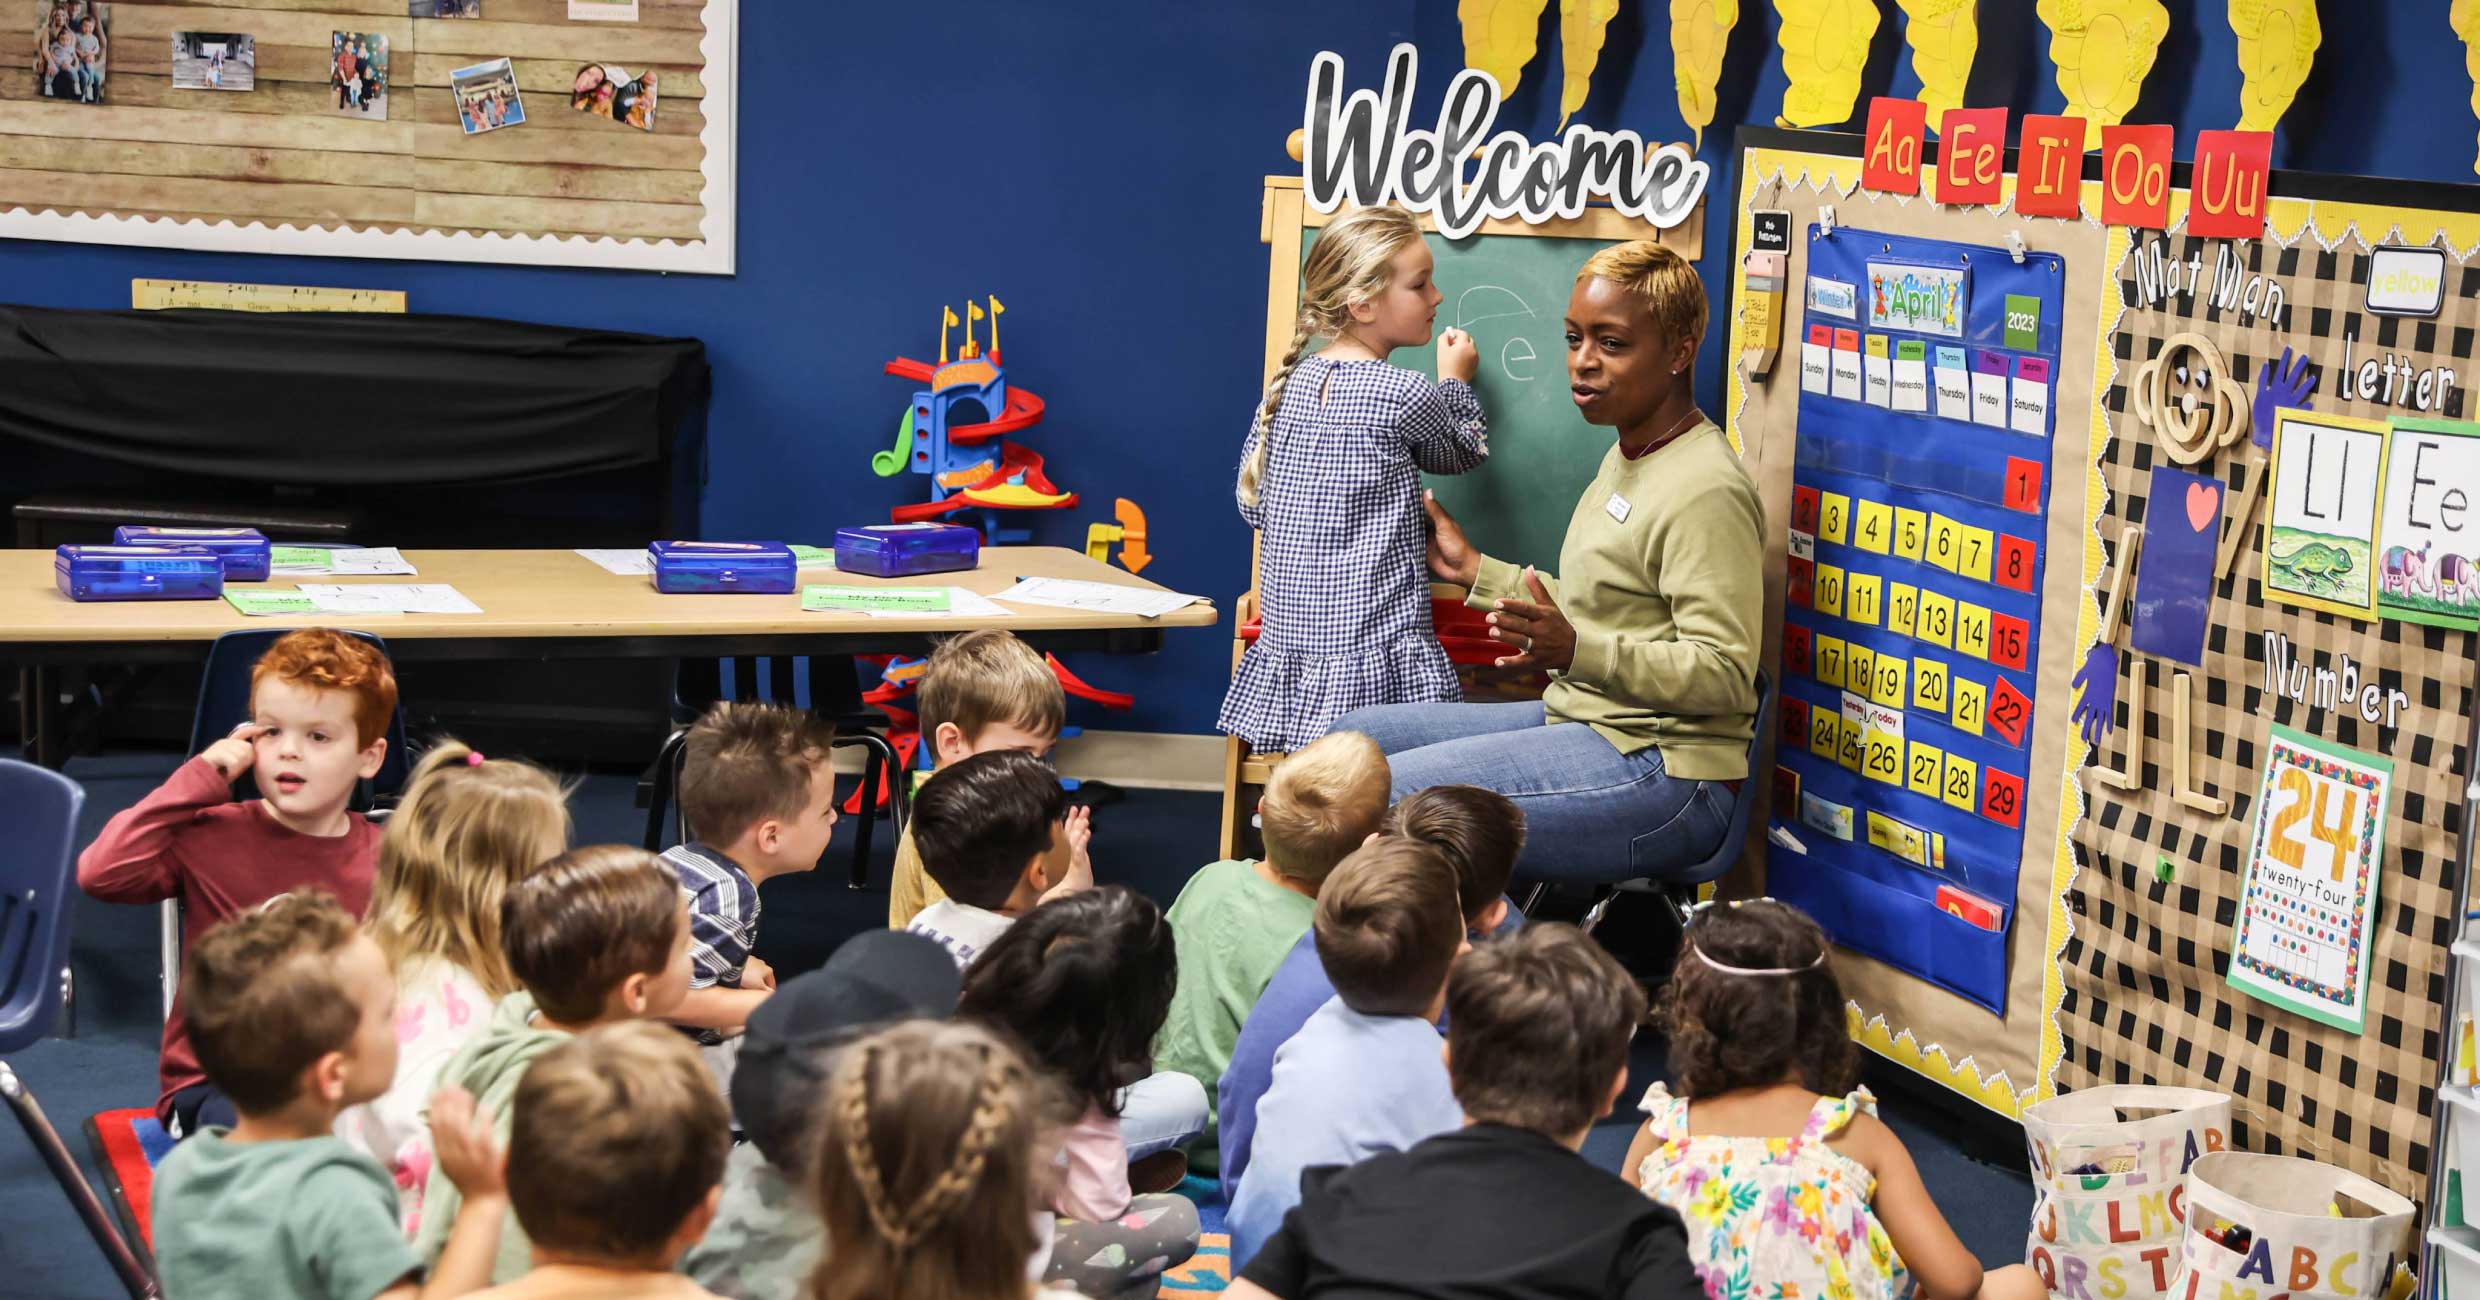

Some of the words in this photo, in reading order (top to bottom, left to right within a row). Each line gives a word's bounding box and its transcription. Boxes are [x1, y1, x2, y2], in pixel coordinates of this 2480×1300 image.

[1310, 52, 1701, 230] Welcome
[1869, 117, 1916, 176] Aa
[1949, 123, 1997, 187] Ee
[2033, 136, 2069, 195] Ii
[2110, 143, 2164, 207] Oo
[2200, 150, 2260, 218] Uu
[1891, 281, 1942, 325] April
[2007, 312, 2035, 333] 2023
[2133, 239, 2203, 310] Mat
[2208, 243, 2286, 325] Man
[2372, 267, 2439, 297] yellow
[1501, 336, 1537, 382] e
[1805, 362, 1825, 377] Sunday
[1835, 367, 1857, 382] Monday
[1868, 374, 1887, 388] Tuesday
[1894, 379, 1925, 392] Wednesday
[1938, 386, 1966, 402] Thursday
[1979, 393, 1999, 408] Friday
[2014, 398, 2043, 415] Saturday
[2017, 472, 2026, 503] 1
[2408, 441, 2468, 532] Ee
[1800, 497, 1811, 526] 2
[1828, 505, 1839, 534] 3
[1865, 513, 1878, 543] 4
[1905, 522, 1916, 550] 5
[1938, 527, 1950, 556] 6
[1970, 540, 1982, 569] 7
[2008, 548, 2021, 579] 8
[1819, 575, 1838, 606] 10
[1854, 585, 1872, 616] 11
[1896, 596, 1913, 627] 12
[1924, 605, 1947, 636] 13
[1963, 617, 1984, 648] 14
[1998, 629, 2021, 659] 15
[1821, 648, 1840, 678] 17
[1852, 663, 1868, 695] 18
[1877, 667, 1898, 697] 19
[1920, 670, 1942, 702] 20
[1959, 690, 1979, 722] 21
[1993, 692, 2023, 733] 22
[2262, 630, 2410, 729] Number
[1815, 719, 1834, 750] 24
[1842, 729, 1859, 761] 25
[1868, 742, 1896, 774] 26
[1913, 754, 1936, 787] 27
[1948, 765, 1970, 799] 28
[1990, 782, 2015, 816] 29
[2267, 766, 2358, 883] 24
[2261, 862, 2348, 908] twenty-four
